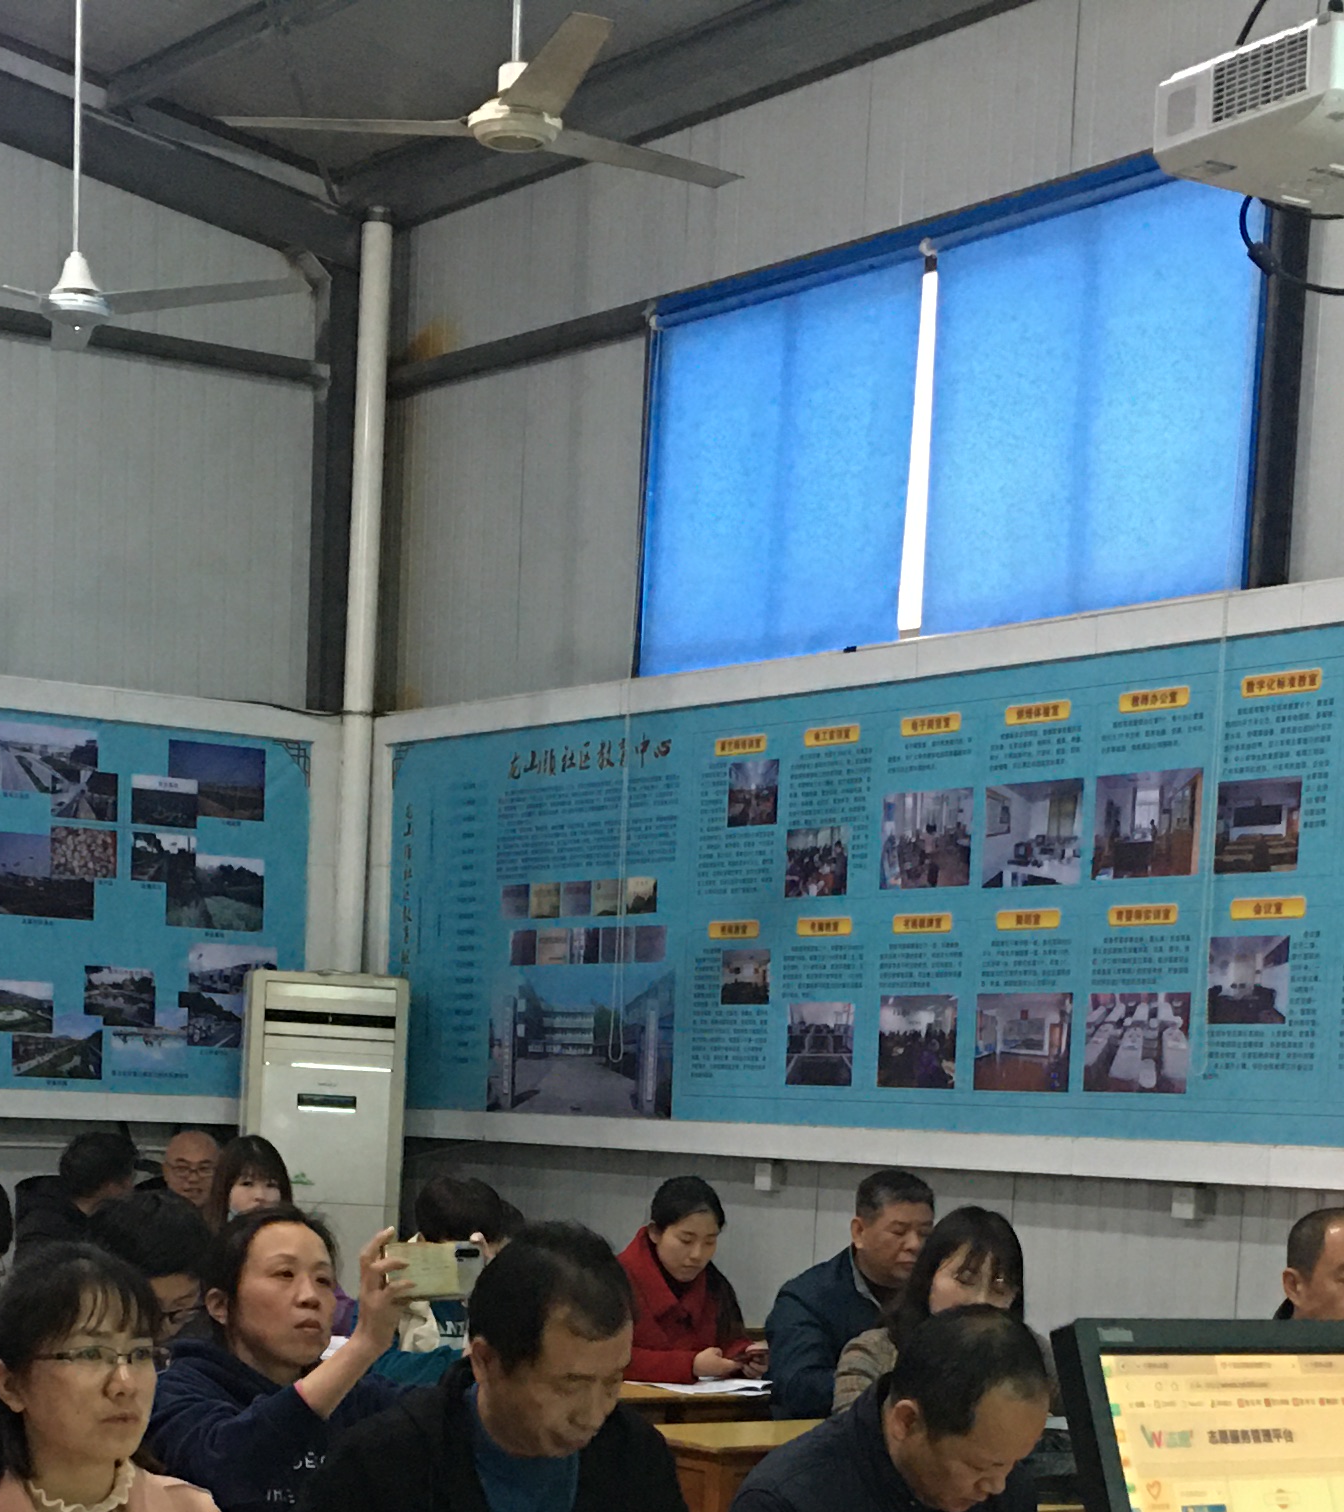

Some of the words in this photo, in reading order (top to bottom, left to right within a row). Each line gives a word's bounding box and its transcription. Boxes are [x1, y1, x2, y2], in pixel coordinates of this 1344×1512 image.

[507, 732, 673, 780] 龙山镇社区教育中心
[1252, 899, 1284, 916] 会议室
